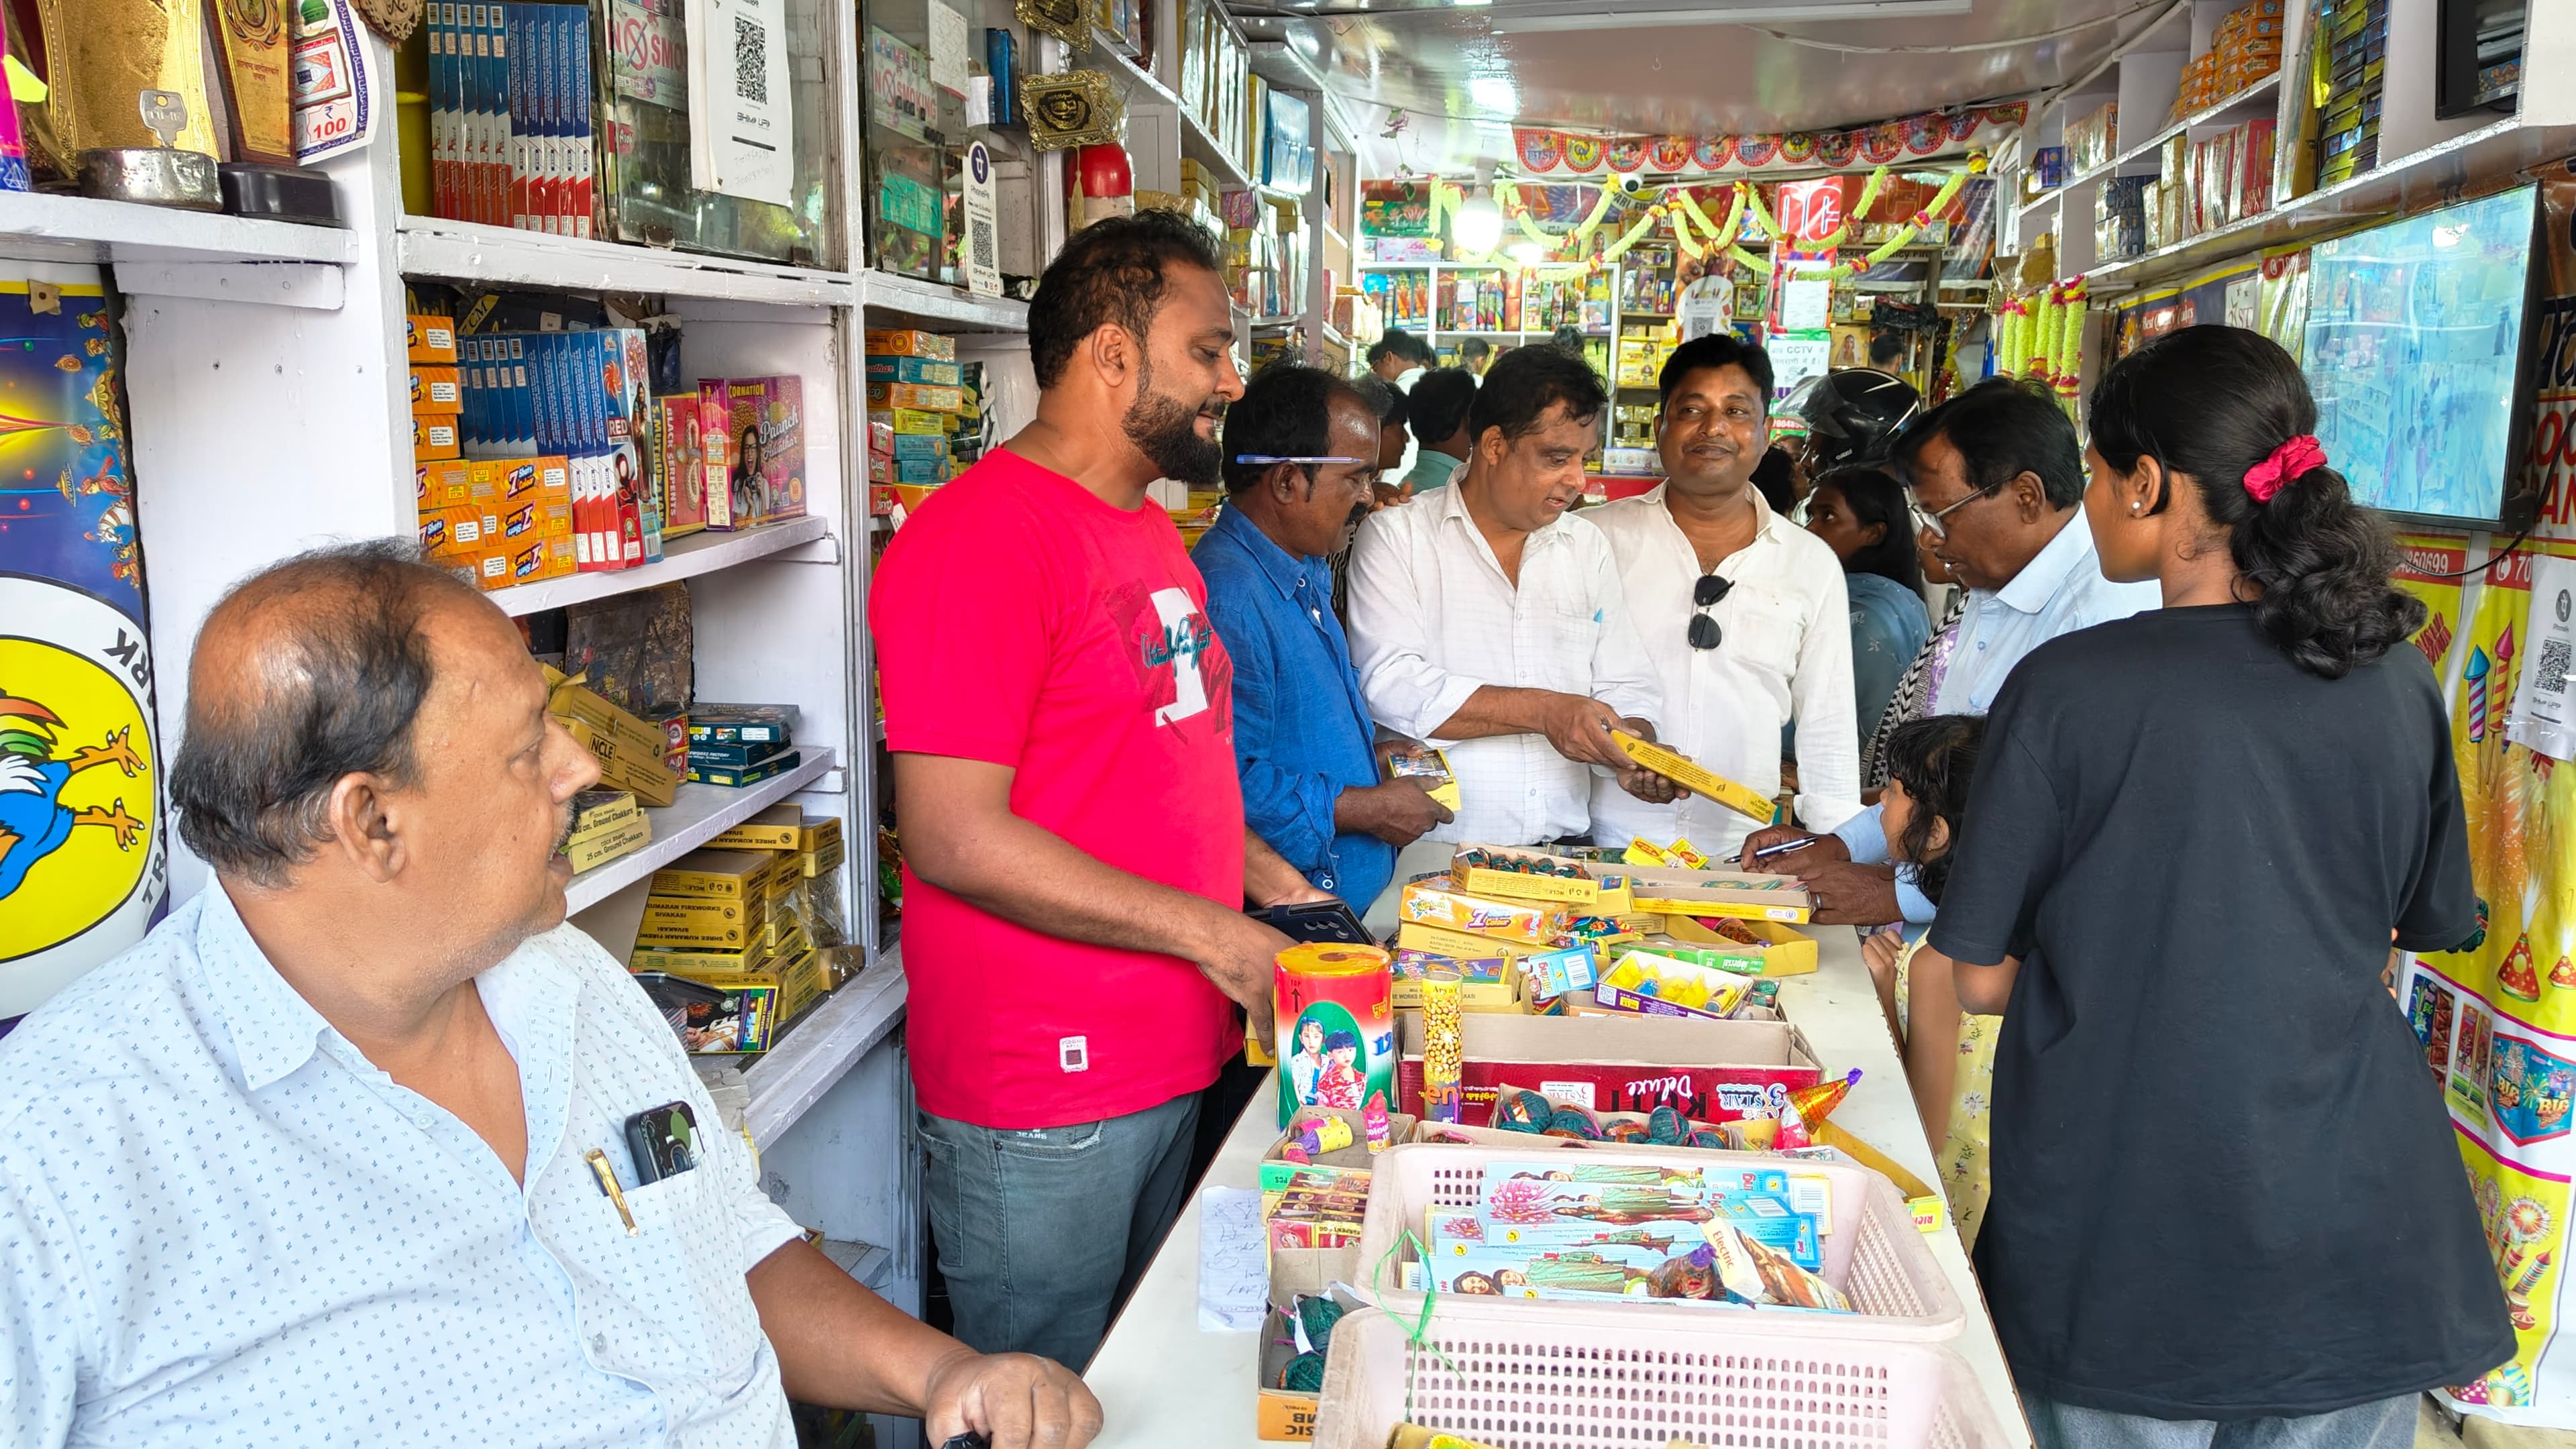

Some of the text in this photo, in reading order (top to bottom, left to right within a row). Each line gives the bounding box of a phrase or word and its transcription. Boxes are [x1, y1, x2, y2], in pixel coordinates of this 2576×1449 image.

[651, 34, 688, 72] SMO
[897, 81, 936, 119] SMOKING
[313, 117, 346, 139] 100
[729, 384, 765, 398] CORNATION
[608, 419, 629, 437] RED
[665, 407, 677, 517] BLACK SERPENTS
[506, 465, 533, 499] 7 Shots
[428, 520, 443, 535] Shots
[591, 737, 613, 759] NCLE
[592, 815, 612, 828] Ground
[612, 808, 634, 822] Chakkars
[603, 842, 622, 854] Ground
[622, 831, 643, 846] Chakkars
[612, 832, 625, 842] BRAND
[1467, 908, 1487, 930] 7
[1485, 918, 1513, 928] Colour
[1625, 1075, 1693, 1102] Deluxe
[1721, 1083, 1786, 1109] 3 STAR
[2538, 1097, 2570, 1114] BIG
[1016, 1131, 1047, 1140] JEANS
[1275, 1176, 1288, 1184] PCS
[1711, 1230, 1735, 1269] Electric
